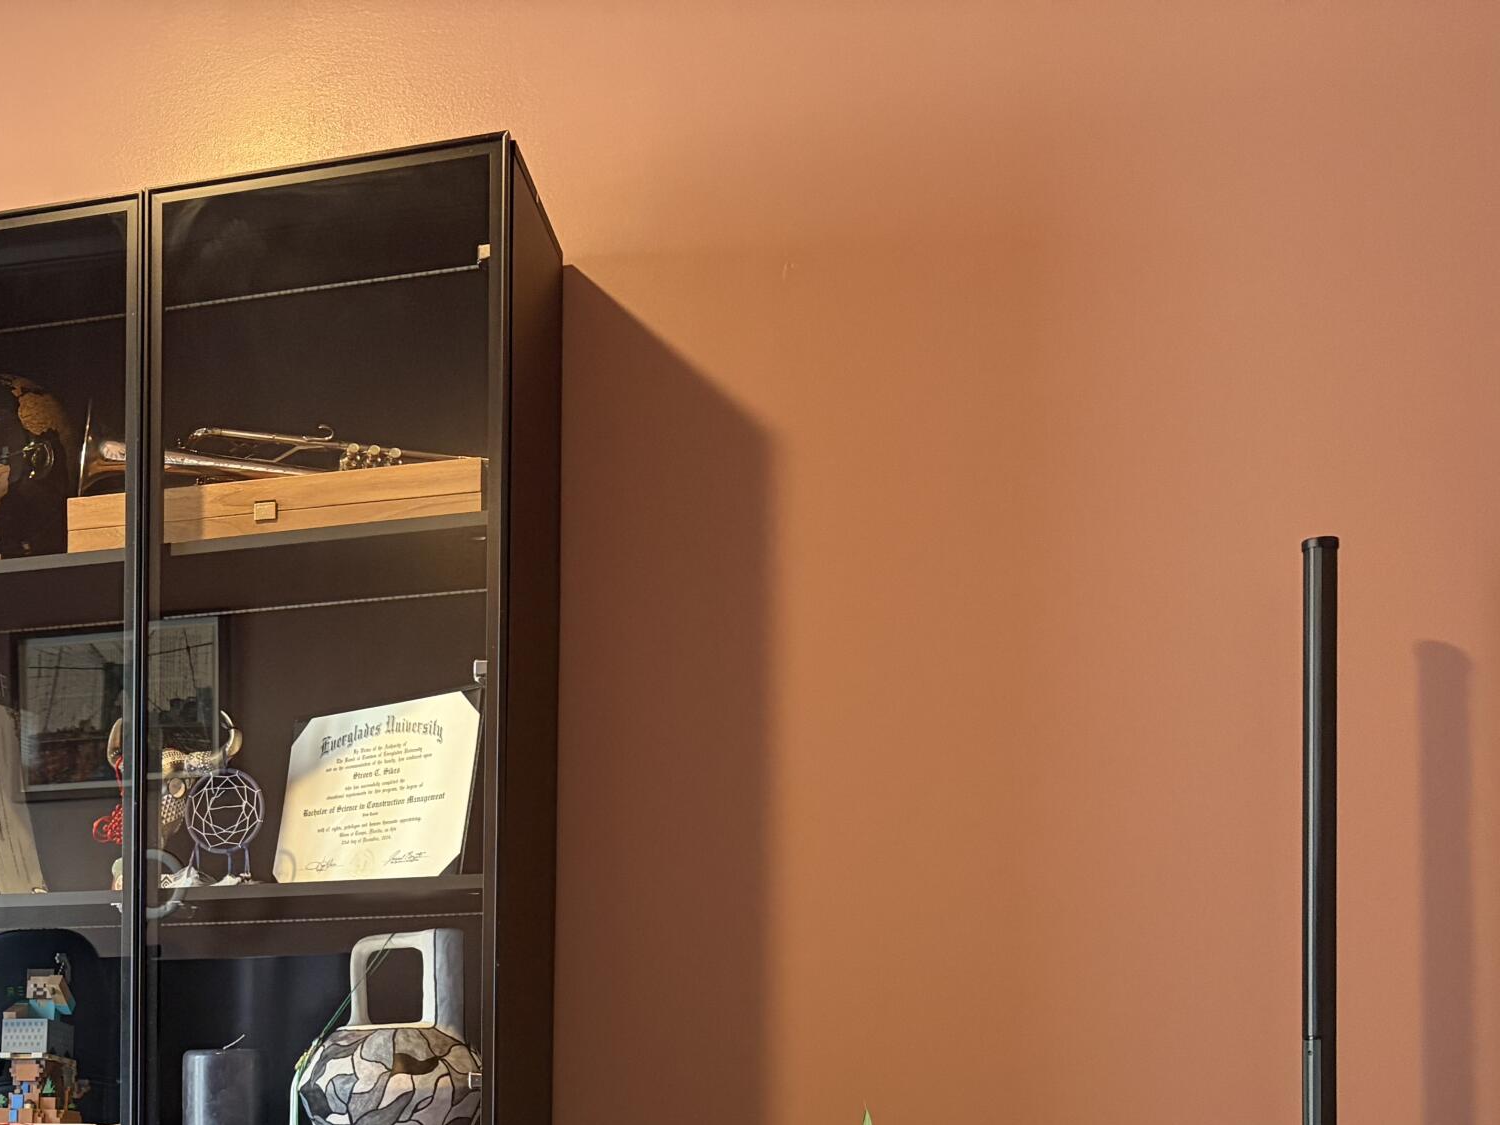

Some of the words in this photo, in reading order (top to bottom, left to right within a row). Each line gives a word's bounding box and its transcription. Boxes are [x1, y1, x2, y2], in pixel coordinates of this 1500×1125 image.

[319, 721, 382, 759] Everglades
[384, 715, 444, 743] University
[302, 808, 328, 818] Bachelor
[336, 804, 357, 813] Science
[366, 798, 405, 809] Construction
[406, 792, 446, 804] Management
